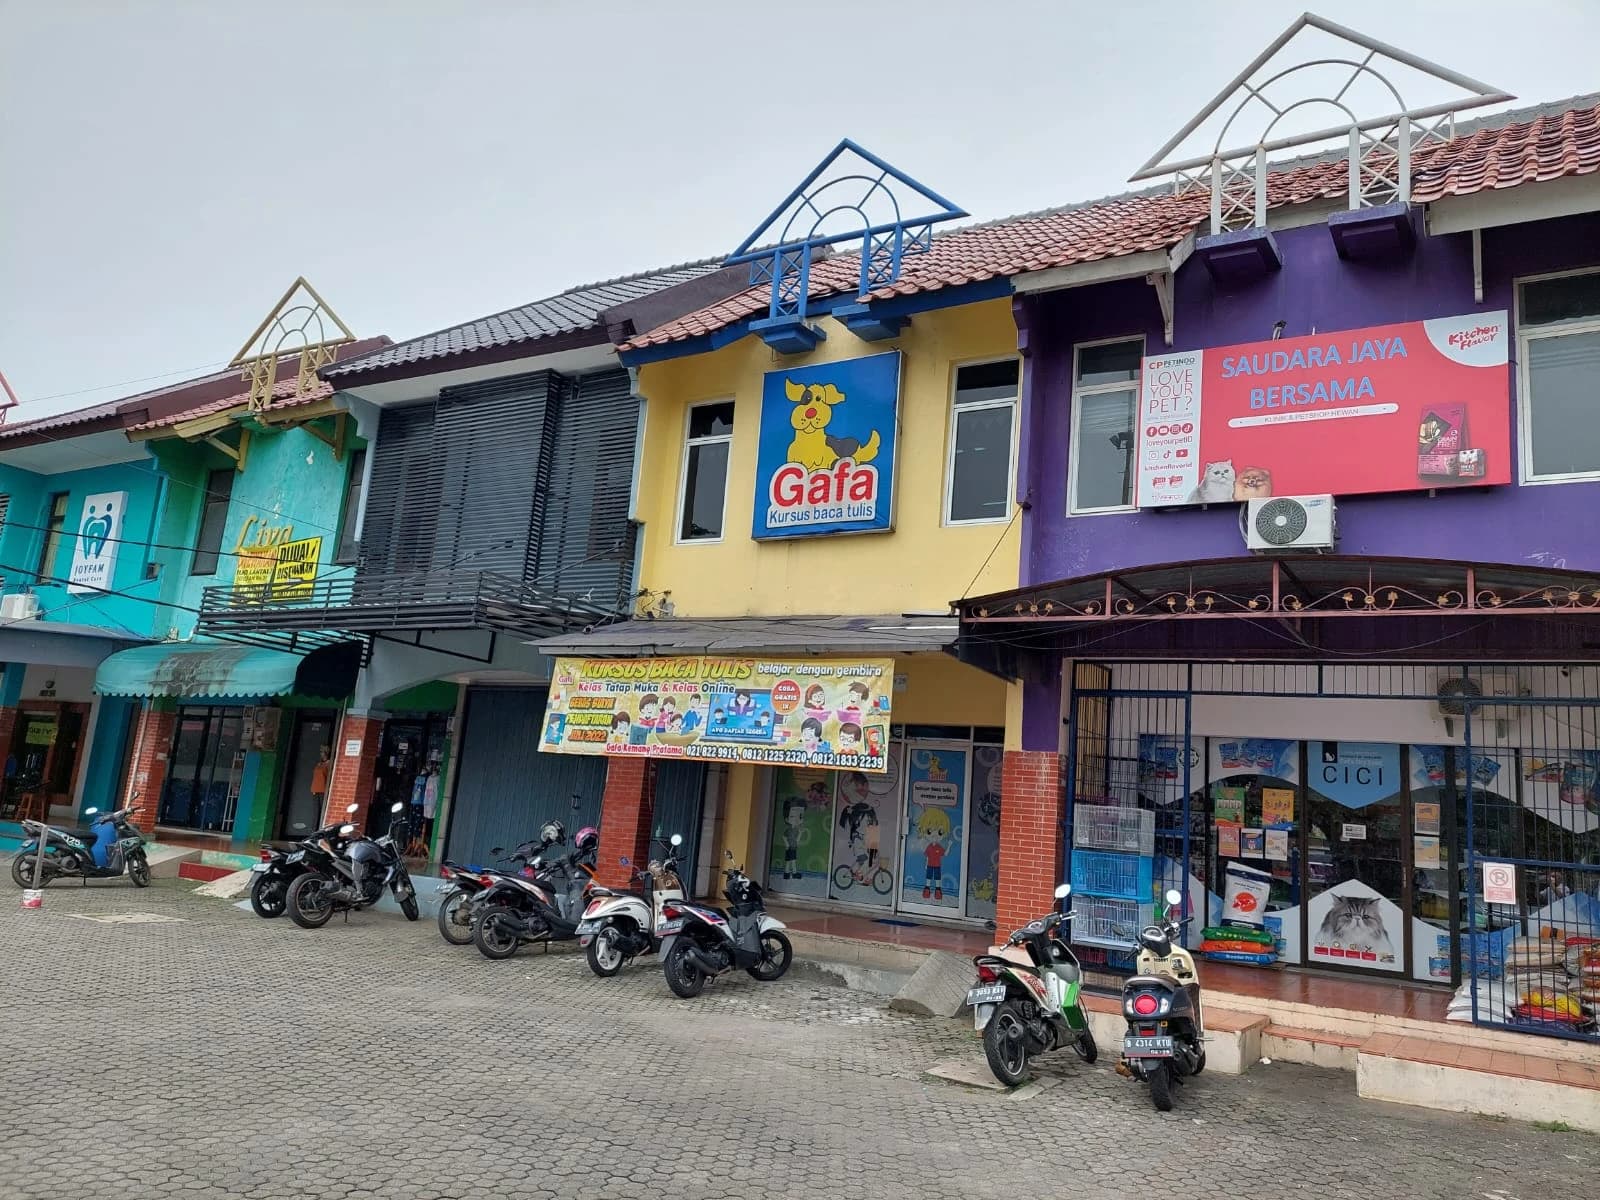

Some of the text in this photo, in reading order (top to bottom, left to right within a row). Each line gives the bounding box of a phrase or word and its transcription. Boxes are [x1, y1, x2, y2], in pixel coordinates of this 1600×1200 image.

[1448, 325, 1499, 346] Kitchen
[1460, 333, 1497, 350] Flavor
[1221, 336, 1408, 378] SAUDARA JAYA
[1150, 369, 1193, 386] LOVE
[1150, 382, 1193, 398] YOUR
[1250, 376, 1375, 409] BERSAMA
[1149, 397, 1181, 414] PET
[773, 460, 874, 507] Gafa
[769, 502, 873, 524] Kursus baca tulis
[75, 563, 105, 576] JOYFAM
[581, 659, 882, 680] KURSUS BACA TULIS belajar dengan gembira
[578, 682, 735, 694] Kelas Tatap Muka & Kelas Online
[606, 742, 622, 752] Gafa
[686, 745, 700, 757] 021
[701, 746, 717, 758] 822
[717, 746, 739, 761] 9914,
[742, 748, 762, 761] 0812
[763, 749, 785, 762] 1225
[812, 752, 833, 765] 0812
[835, 754, 857, 768] 1833
[858, 756, 884, 770] 2239
[1323, 766, 1384, 786] CICI
